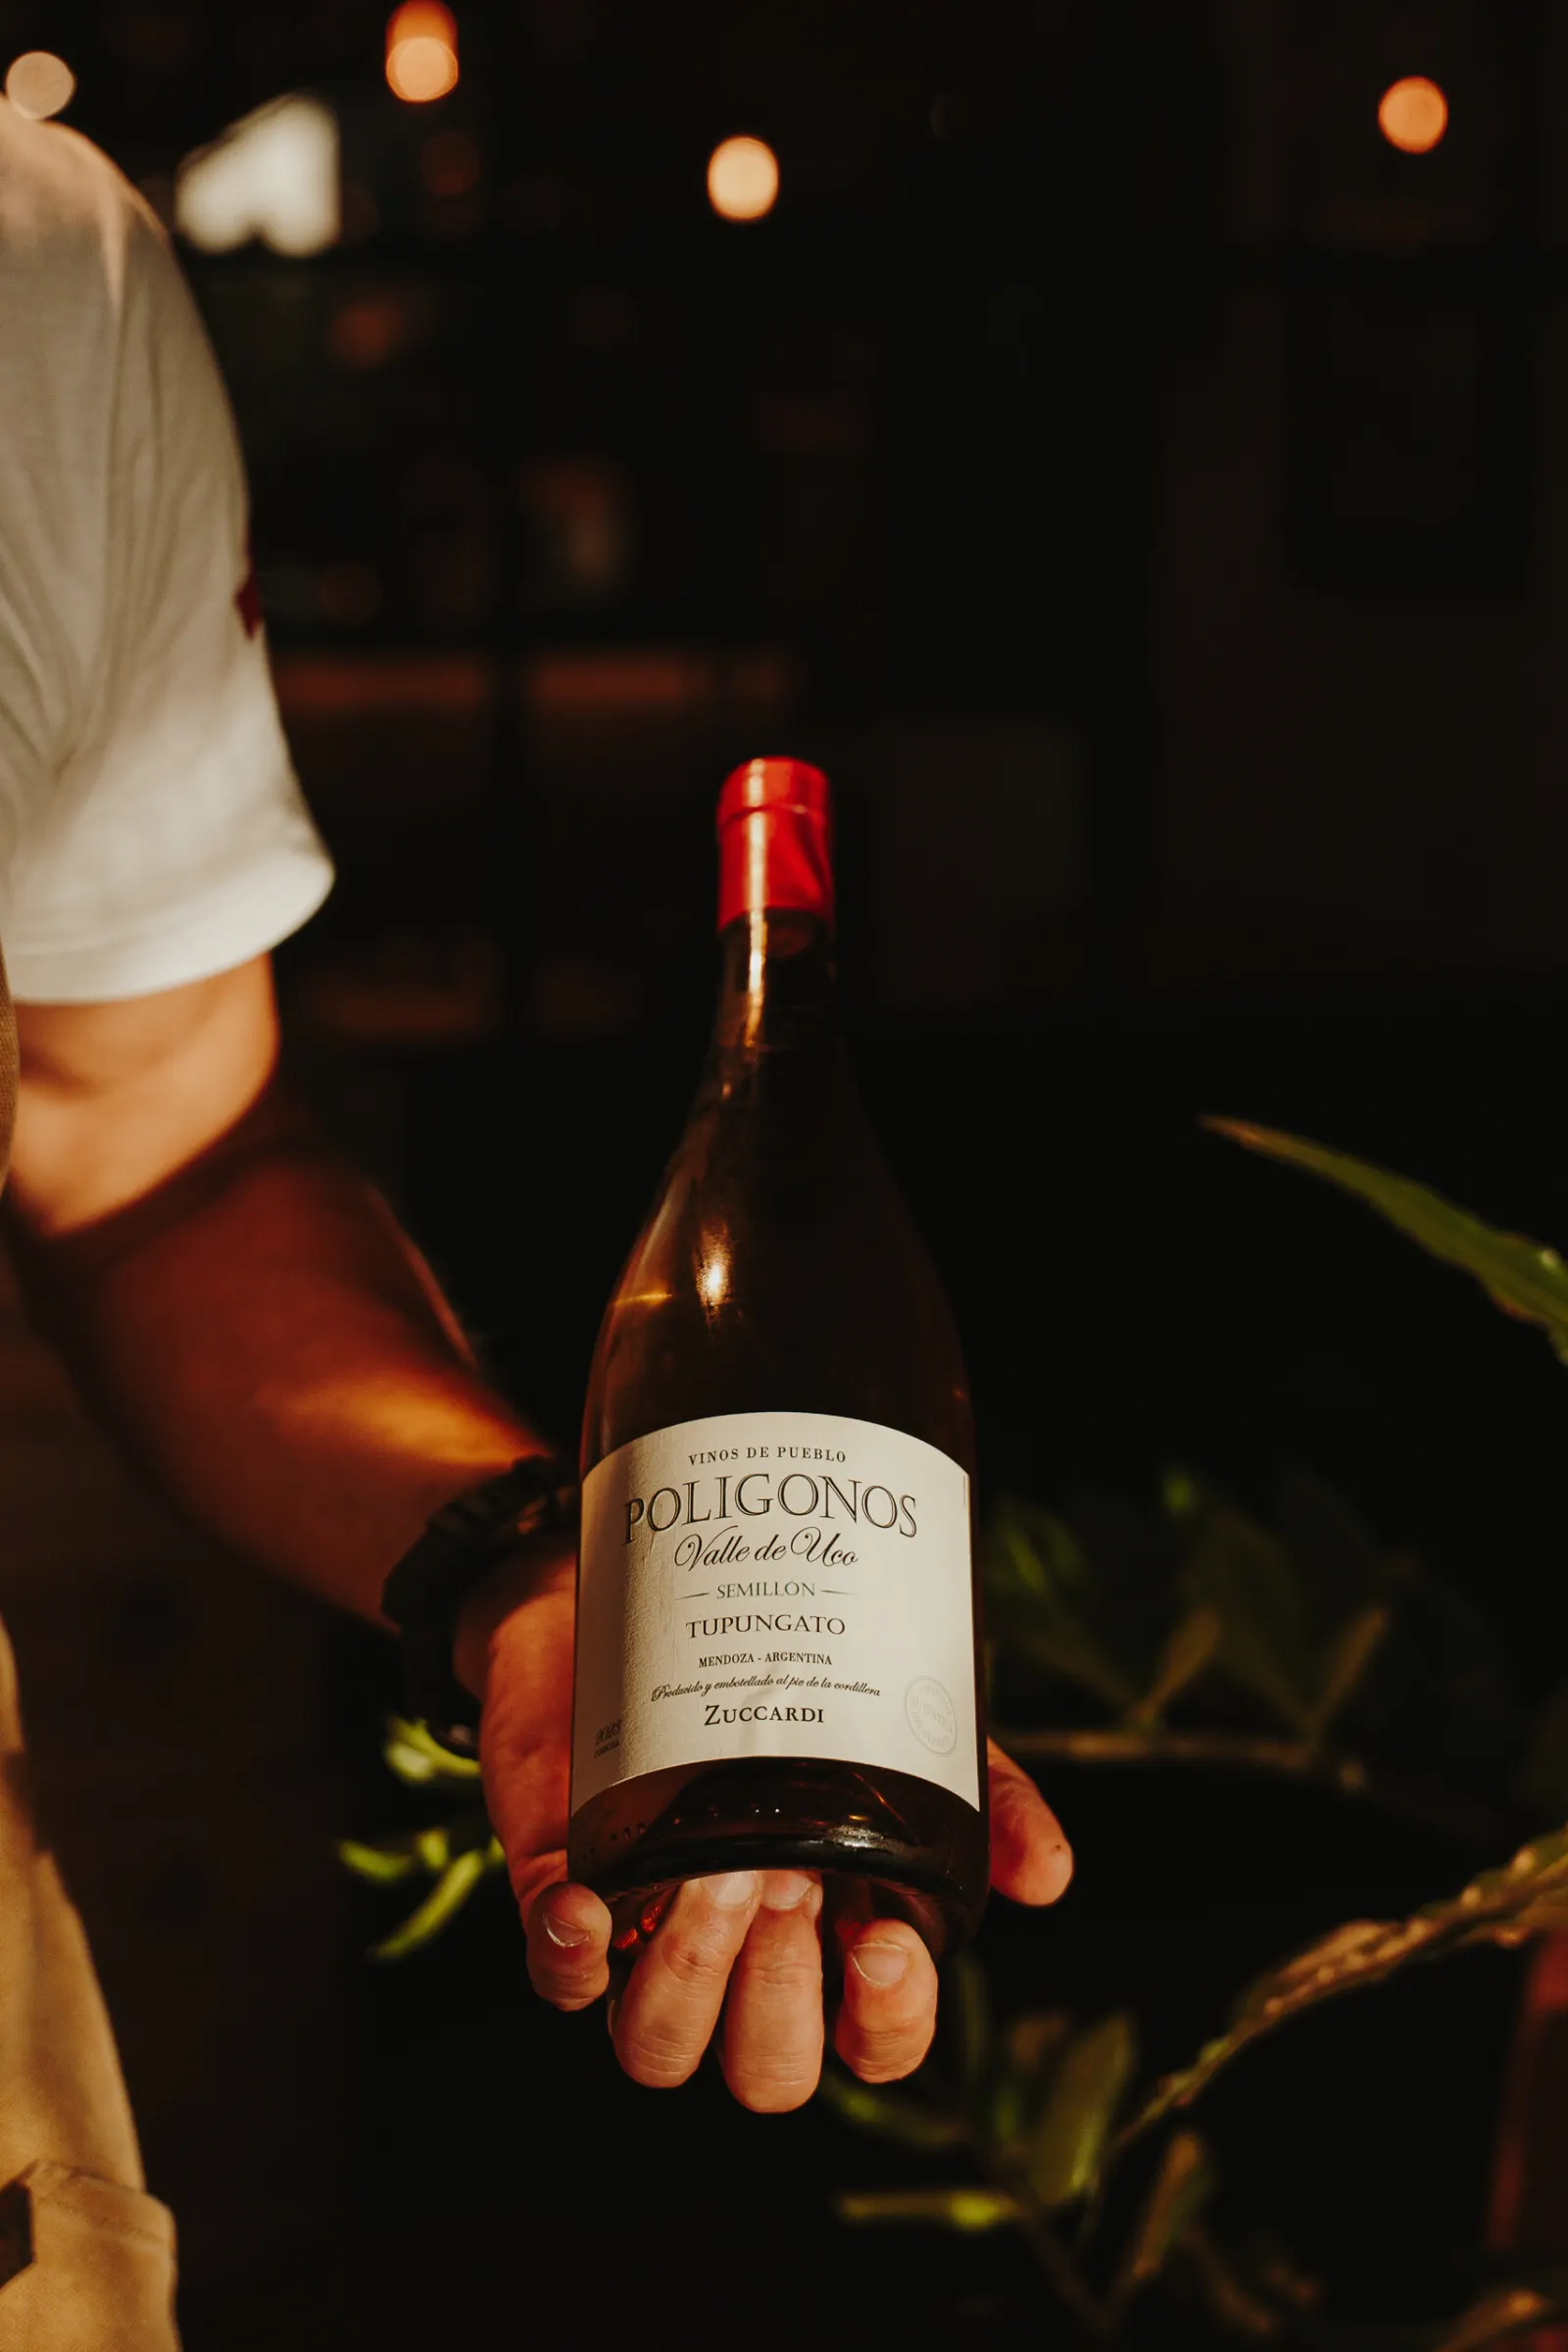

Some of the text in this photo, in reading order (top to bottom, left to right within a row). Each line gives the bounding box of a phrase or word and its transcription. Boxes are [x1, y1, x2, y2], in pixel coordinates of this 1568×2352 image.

[688, 1446, 847, 1466] VINOS DE PUEBLO
[621, 1473, 917, 1546] POLIGONOS
[674, 1525, 859, 1572] Valle de Uco
[686, 1614, 846, 1639] TUPUNGATO
[698, 1654, 755, 1669] MENDOZA
[764, 1651, 833, 1666] ARGENTINA
[651, 1674, 881, 1702] Producido y embotellado al pie de la cordillera
